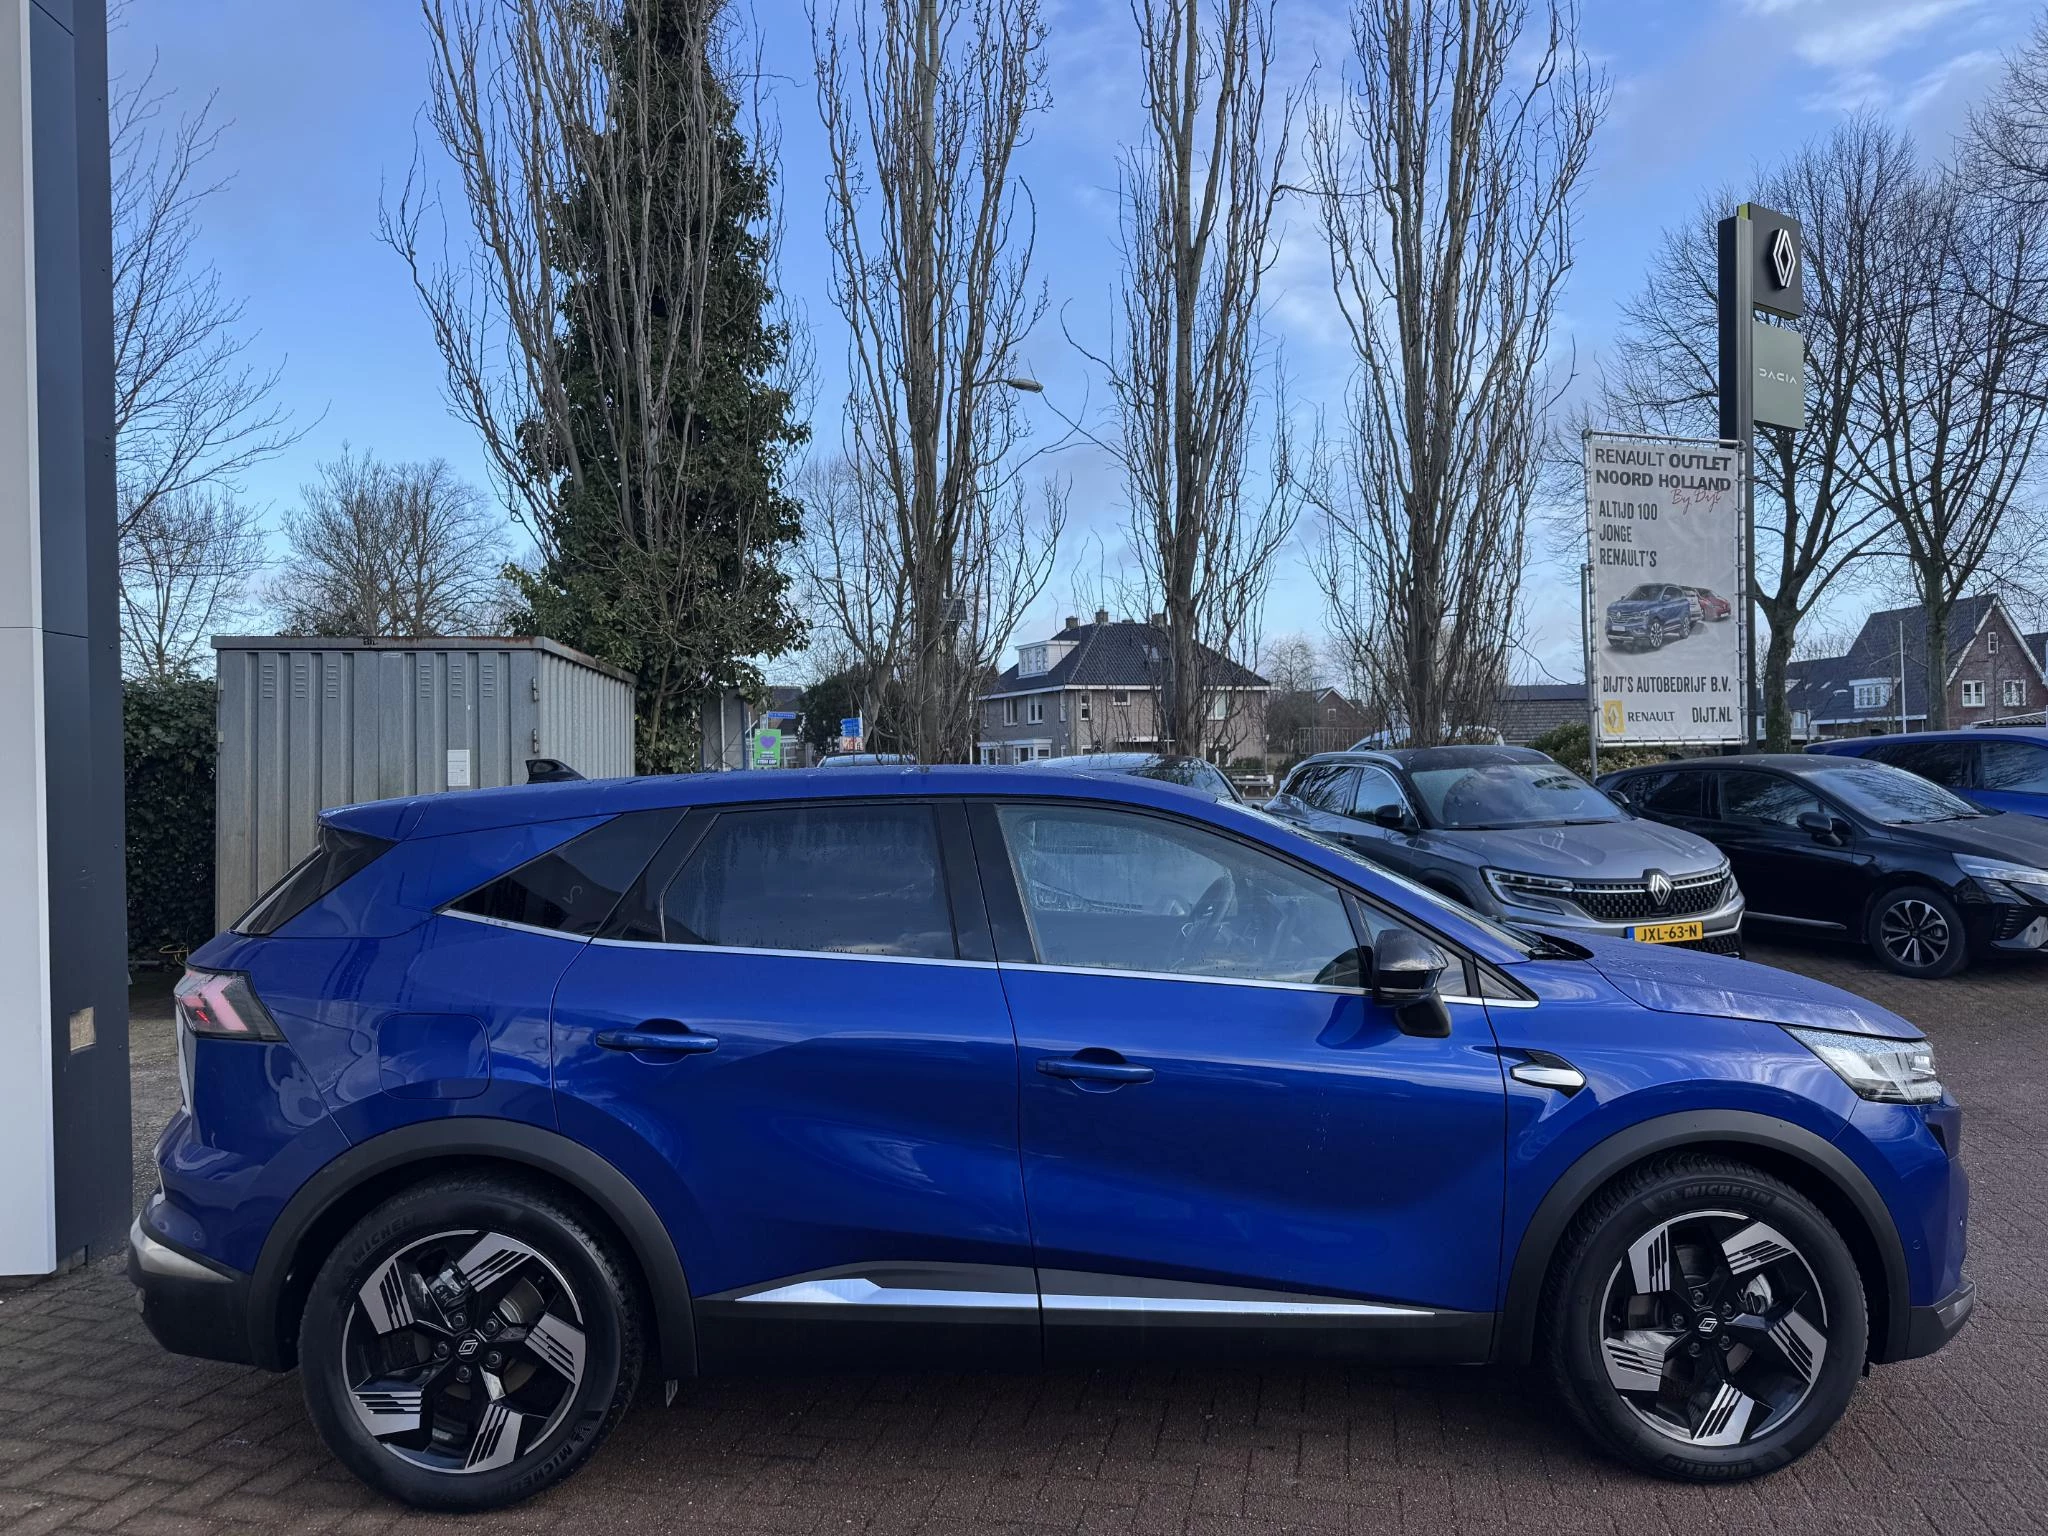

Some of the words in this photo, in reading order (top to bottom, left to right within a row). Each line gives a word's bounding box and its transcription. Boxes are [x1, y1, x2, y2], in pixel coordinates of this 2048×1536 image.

[1759, 367, 1797, 385] DACIA
[1595, 448, 1665, 467] RENAULT
[1668, 453, 1732, 471] OUTLET
[1596, 469, 1653, 487] NOORD
[1658, 473, 1731, 491] HOLLAND
[1599, 500, 1634, 520] ALTIJD
[1637, 503, 1658, 520] 100
[1671, 488, 1692, 515] By
[1599, 524, 1632, 543] JONGE
[1599, 548, 1657, 567] RENAULT'S
[1603, 675, 1634, 693] DIJT'S
[1636, 676, 1707, 693] AUTOBEDRIJF
[1710, 676, 1731, 693] B.V.
[1627, 711, 1676, 722] RENAULT
[1692, 706, 1733, 723] DIJT.NL
[1640, 924, 1698, 942] JXL-63-N
